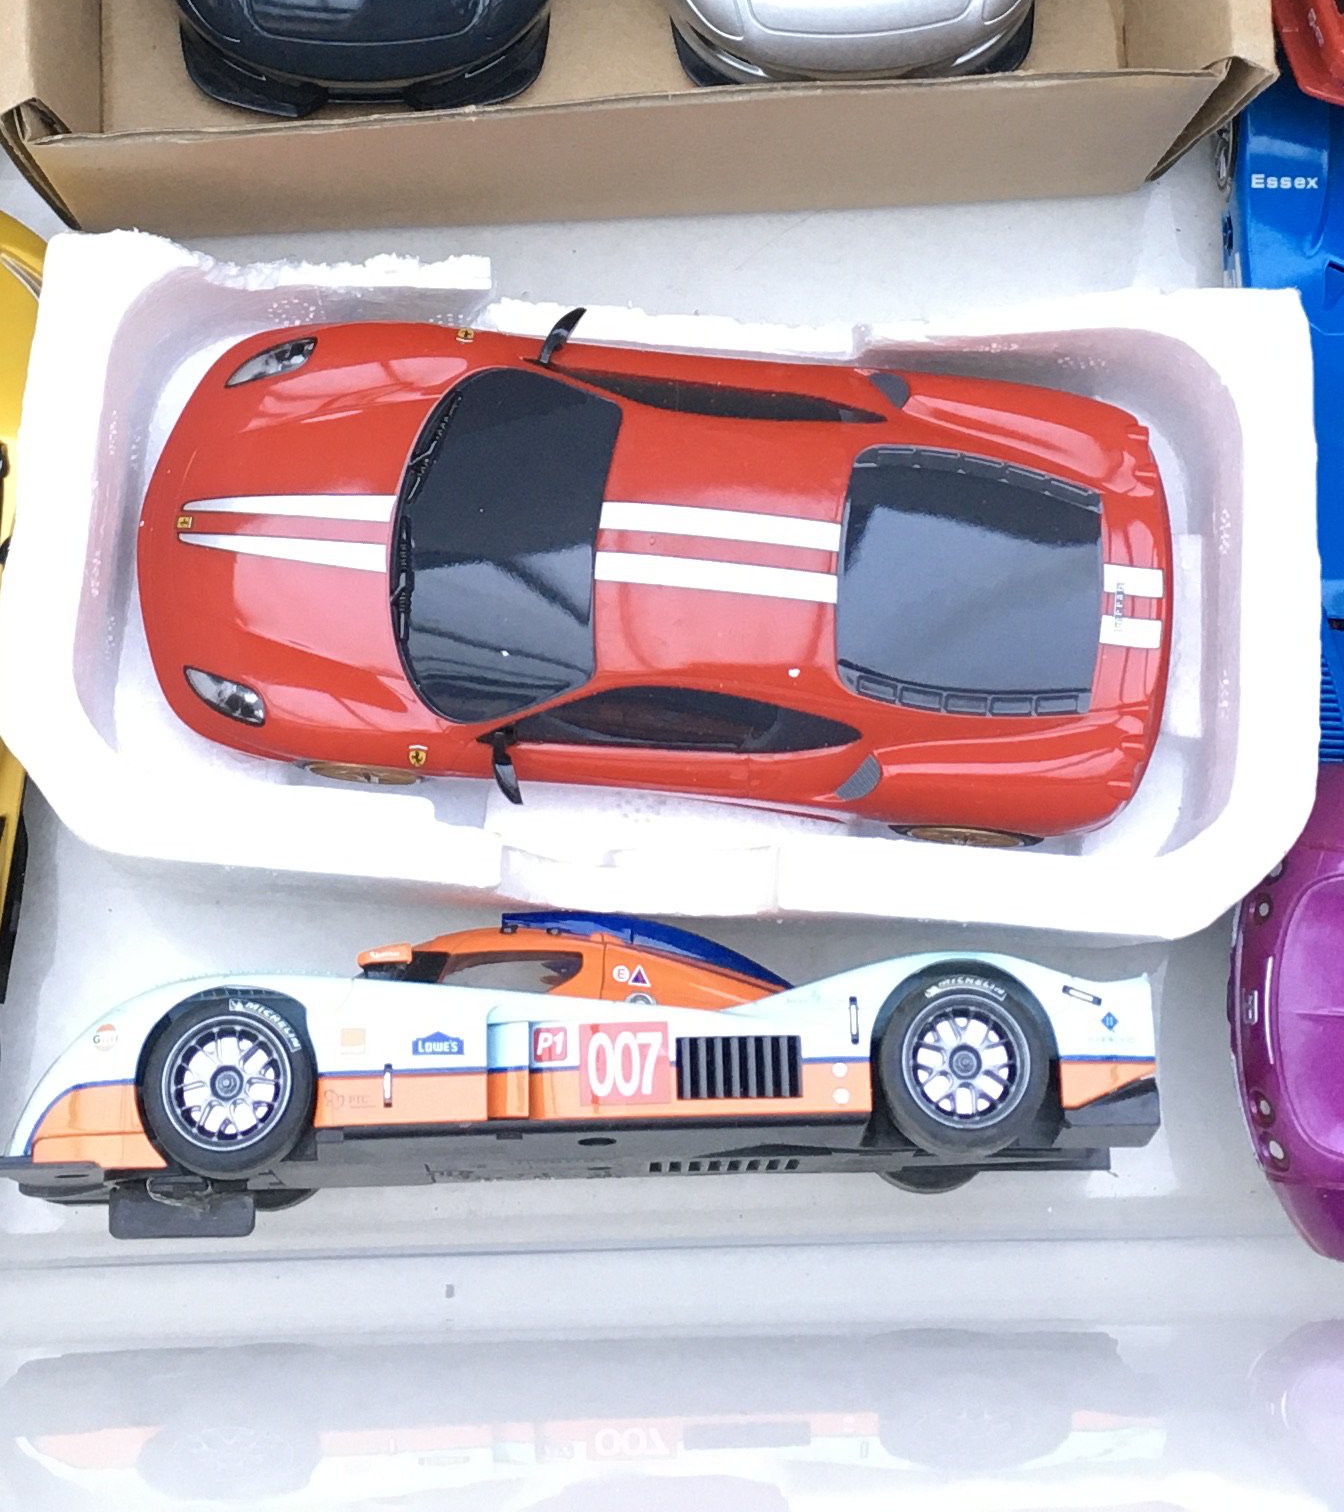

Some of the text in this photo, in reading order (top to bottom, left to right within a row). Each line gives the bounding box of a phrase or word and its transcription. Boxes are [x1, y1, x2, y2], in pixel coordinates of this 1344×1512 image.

[1251, 173, 1319, 189] Essex
[938, 976, 1005, 994] MICHELIN
[246, 1001, 301, 1050] MICHELIN
[417, 1038, 460, 1054] LOWE'S
[536, 1033, 565, 1055] P1
[587, 1031, 663, 1097] 007
